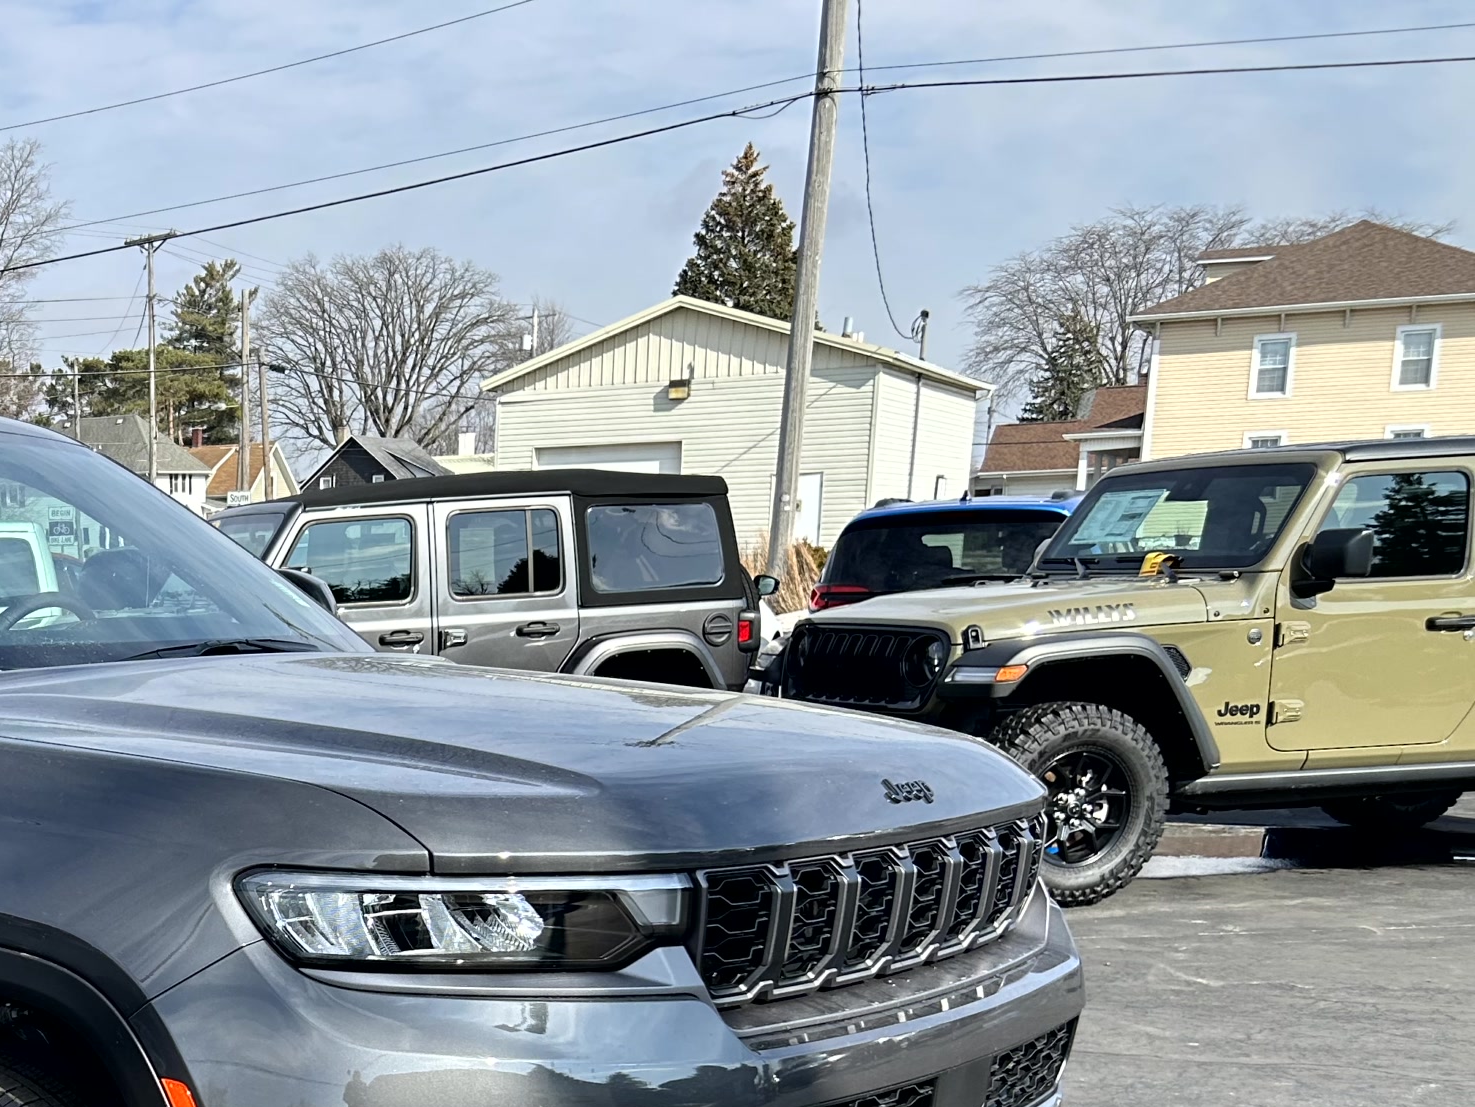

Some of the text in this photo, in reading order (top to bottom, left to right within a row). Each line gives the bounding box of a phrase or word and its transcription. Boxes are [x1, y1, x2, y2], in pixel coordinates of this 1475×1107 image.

[229, 493, 249, 503] SOUTH
[51, 509, 71, 518] BEGIN
[1046, 602, 1136, 627] WILLYS
[1216, 701, 1261, 719] Jeep
[880, 778, 934, 805] Jeep
